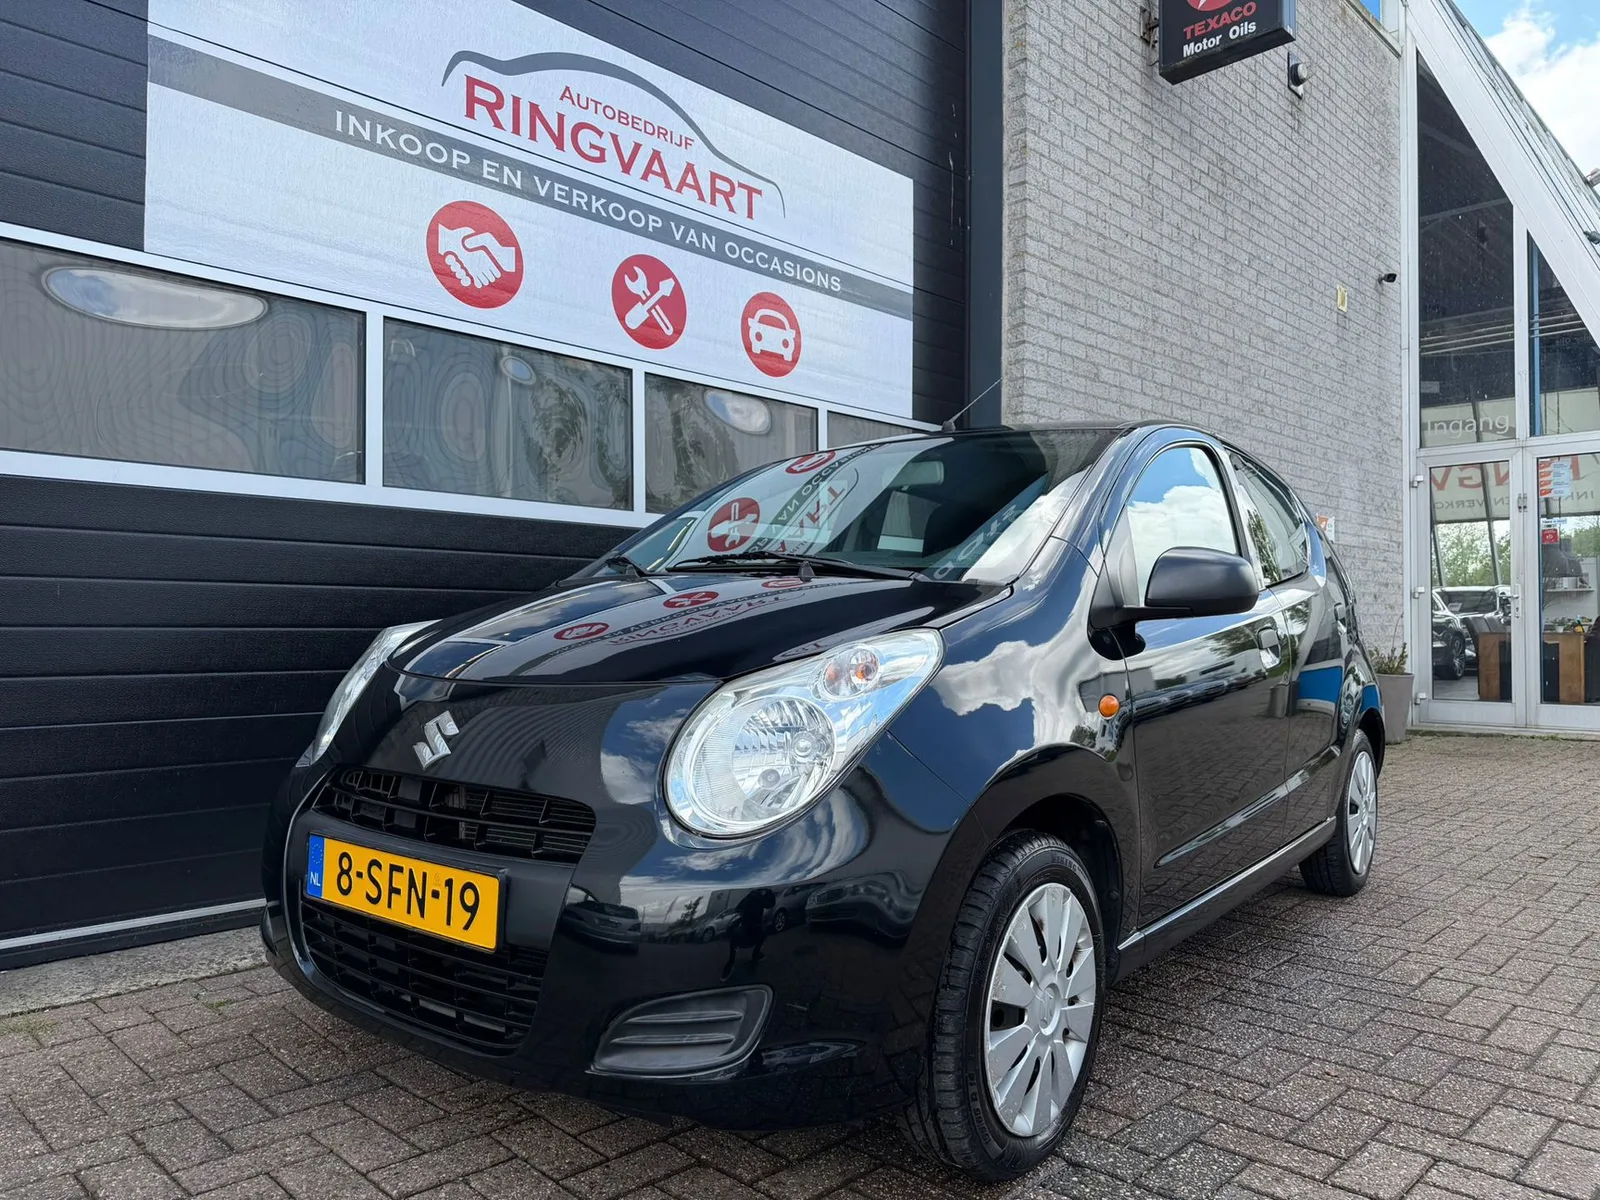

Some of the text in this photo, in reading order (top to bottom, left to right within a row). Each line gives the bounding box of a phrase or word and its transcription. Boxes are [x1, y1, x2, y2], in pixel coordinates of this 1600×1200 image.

[1183, 2, 1257, 40] TEXACO
[1183, 20, 1257, 58] Motor Oils
[464, 74, 762, 220] RINGVAART
[559, 86, 694, 150] AUTOBEDRIJF
[335, 110, 842, 292] INKOOP EN VERKOOP VAN OCCASIONS
[1427, 415, 1509, 439] Ingang
[309, 851, 480, 931] NL 8-SFN-19
